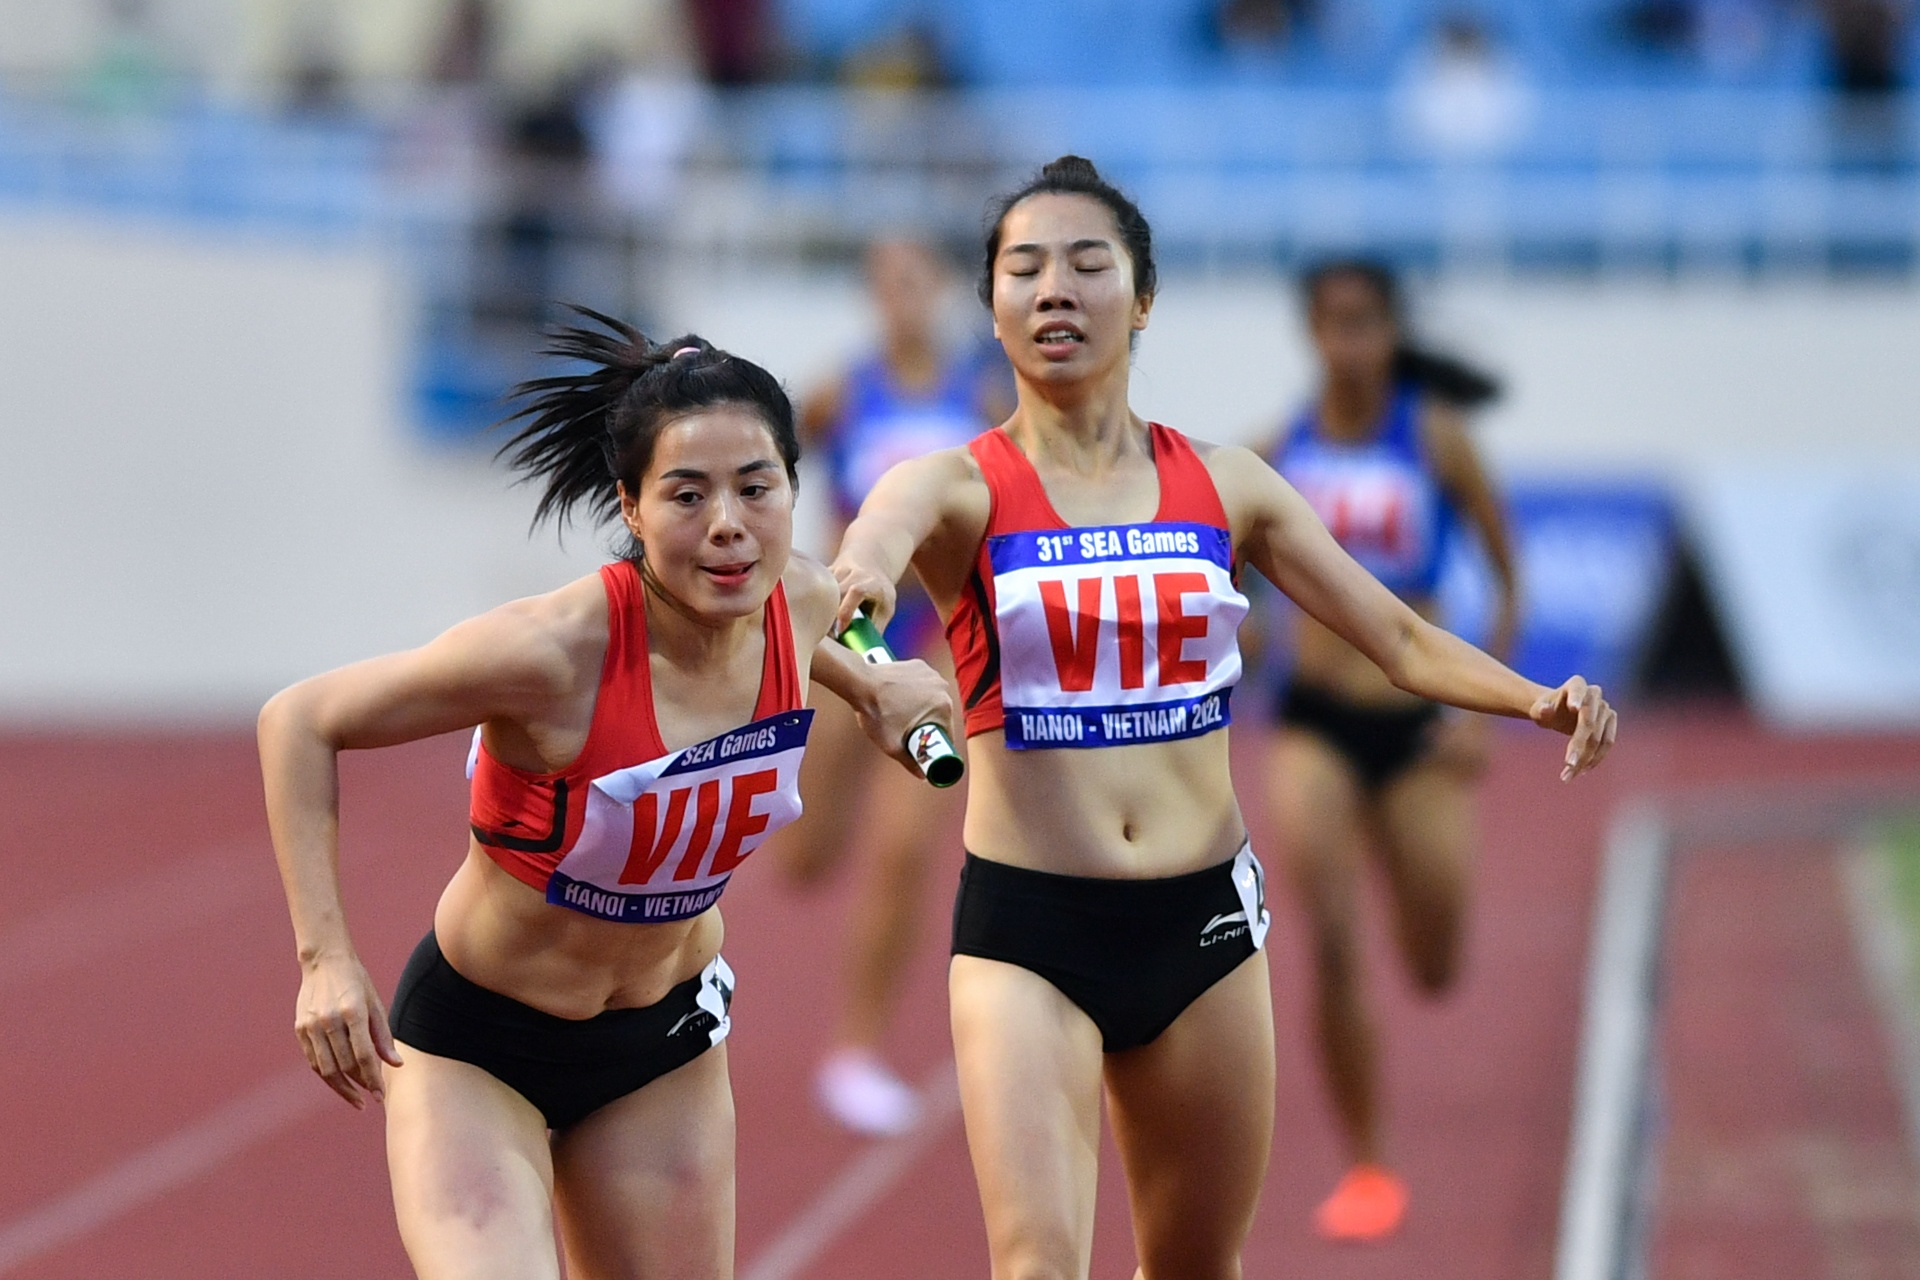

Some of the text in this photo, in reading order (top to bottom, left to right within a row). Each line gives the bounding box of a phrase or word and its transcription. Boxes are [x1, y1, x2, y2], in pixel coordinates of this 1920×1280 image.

[1079, 530, 1123, 558] SEA
[1127, 528, 1200, 555] Games
[1038, 572, 1210, 692] VIE
[1021, 713, 1084, 741] HANOI
[1088, 724, 1097, 733] -
[1102, 711, 1187, 740] VIETNAM
[680, 725, 777, 767] SEA Games
[617, 768, 778, 885] VIE
[564, 882, 625, 917] HANOI
